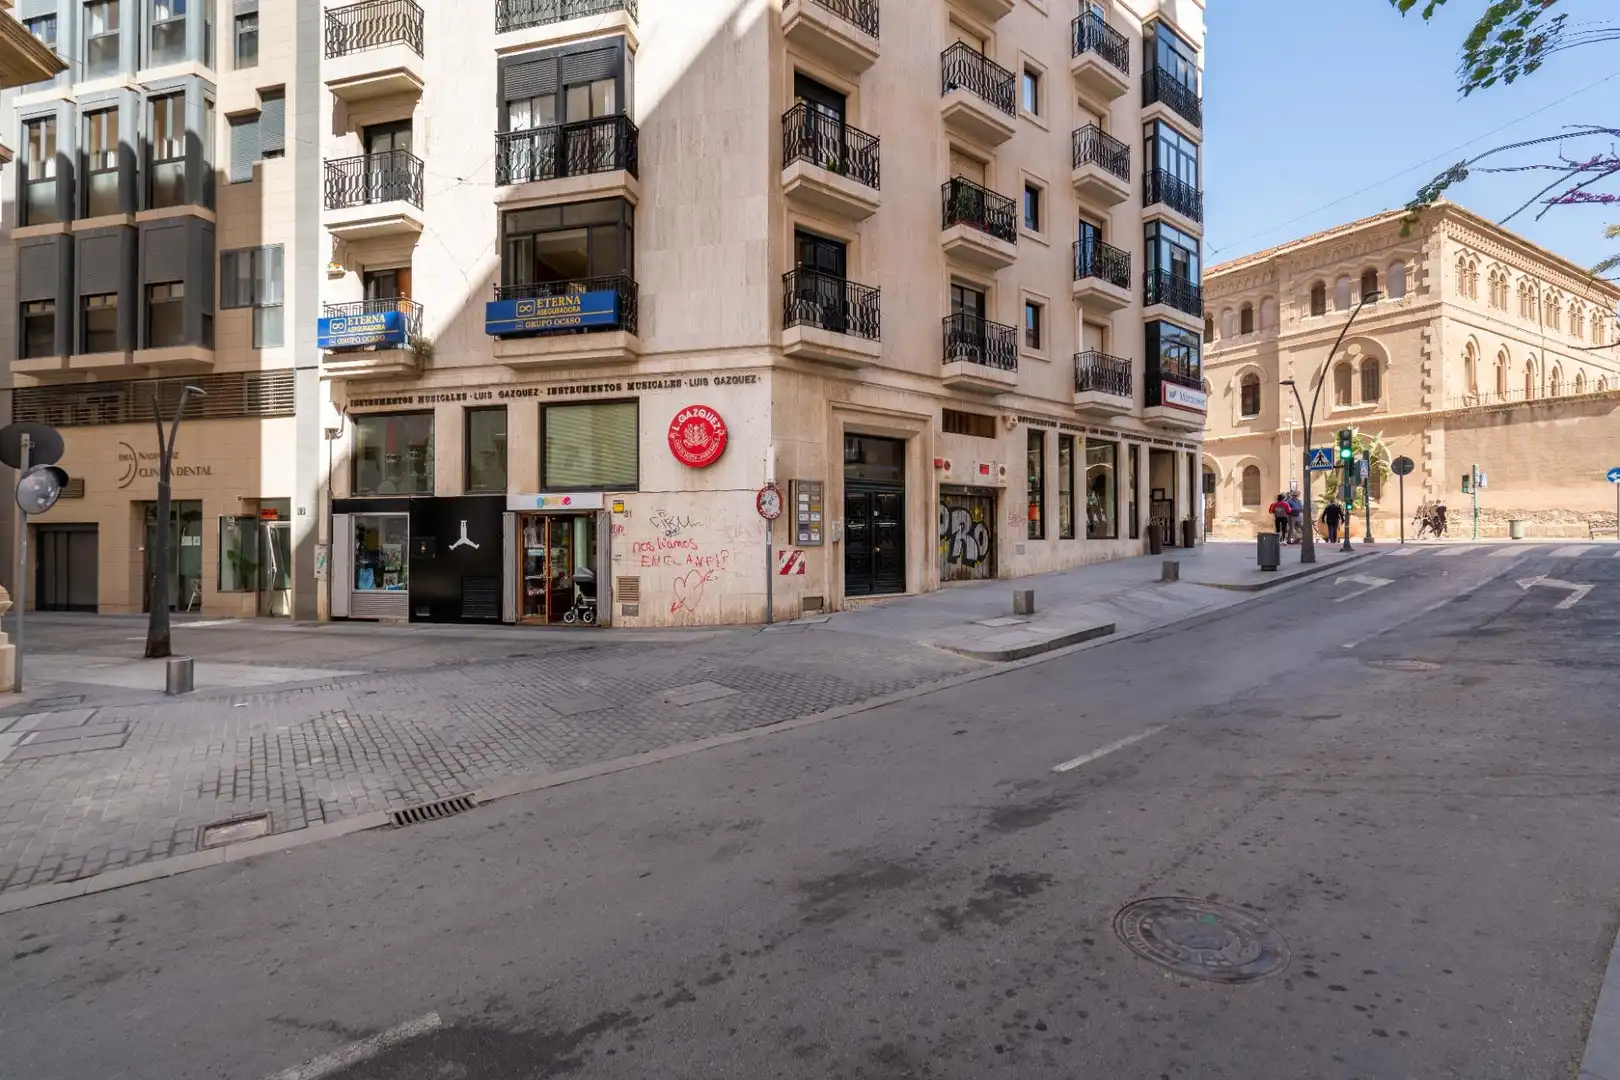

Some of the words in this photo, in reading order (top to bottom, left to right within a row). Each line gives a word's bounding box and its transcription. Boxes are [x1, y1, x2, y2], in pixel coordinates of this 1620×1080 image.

[537, 295, 581, 308] ETERNA
[536, 306, 581, 316] ASEGURADORA
[347, 314, 386, 326] ETERNA
[525, 319, 552, 329] GRUPO
[553, 317, 581, 326] OCASO
[473, 390, 493, 400] LUIS
[498, 388, 539, 399] GAZQUEZ
[546, 382, 622, 396] INSTRUMENTOS
[627, 379, 682, 391] MUSICALES
[688, 378, 709, 388] LUIS
[713, 374, 757, 386] GAZQUEZ
[176, 465, 212, 477] DENTAL
